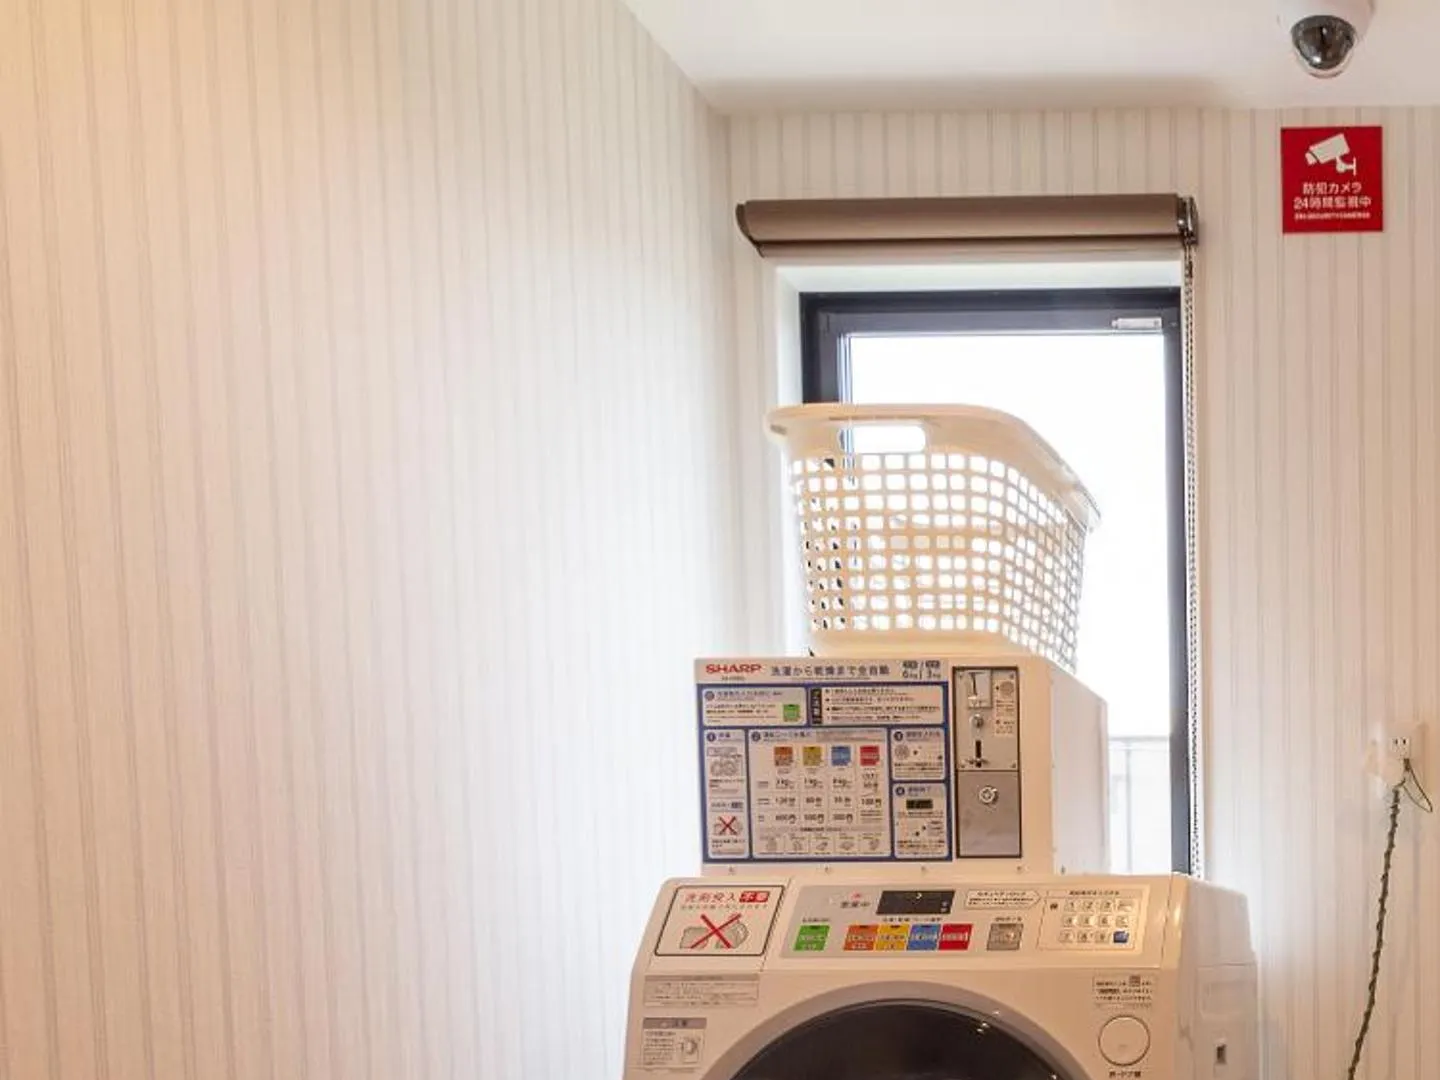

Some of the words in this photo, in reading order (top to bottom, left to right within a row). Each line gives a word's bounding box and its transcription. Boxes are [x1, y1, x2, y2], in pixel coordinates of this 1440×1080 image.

[1303, 182, 1362, 195] 防犯カメラ
[1293, 196, 1372, 210] 24時間監視中
[706, 663, 762, 674] SHARP
